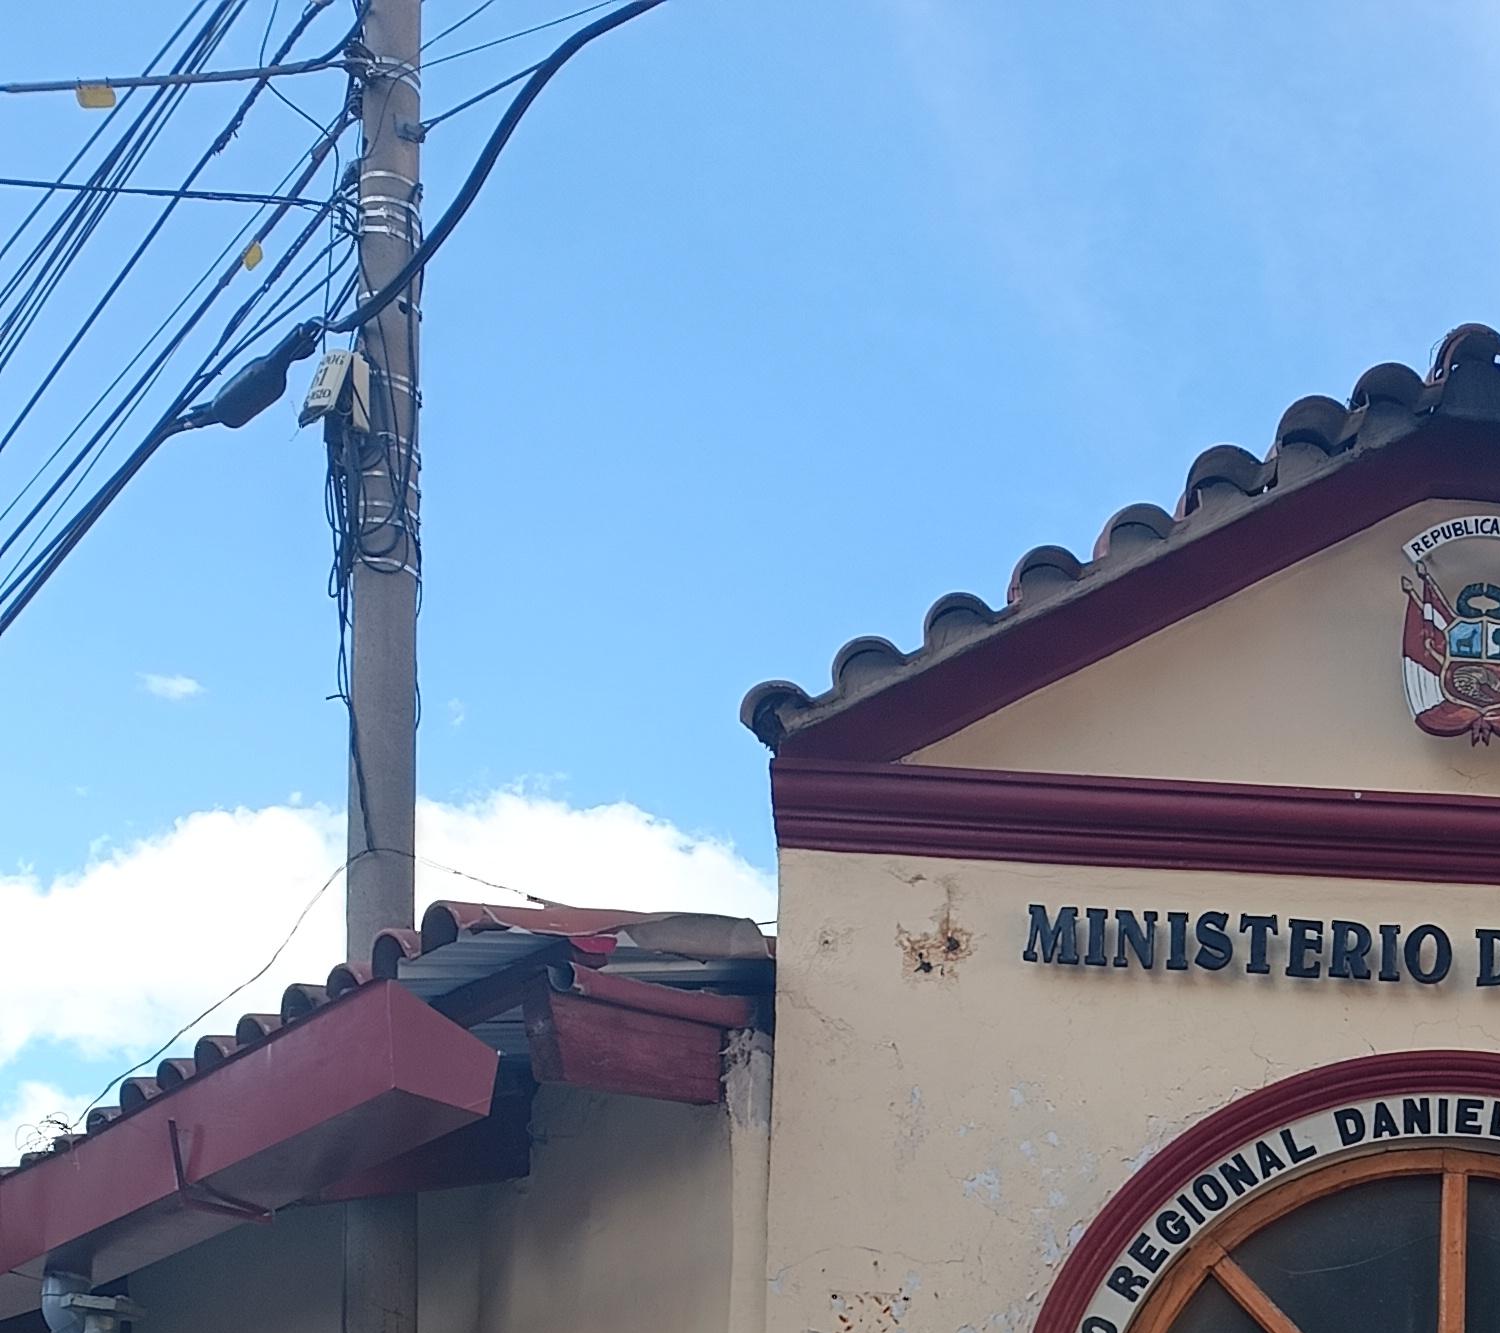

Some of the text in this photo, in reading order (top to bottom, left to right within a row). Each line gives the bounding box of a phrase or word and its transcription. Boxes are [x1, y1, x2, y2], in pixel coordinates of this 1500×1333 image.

[1411, 518, 1500, 556] REPUBLICA
[1022, 903, 1452, 985] MINISTERIO
[1107, 1127, 1317, 1303] REGIONAL
